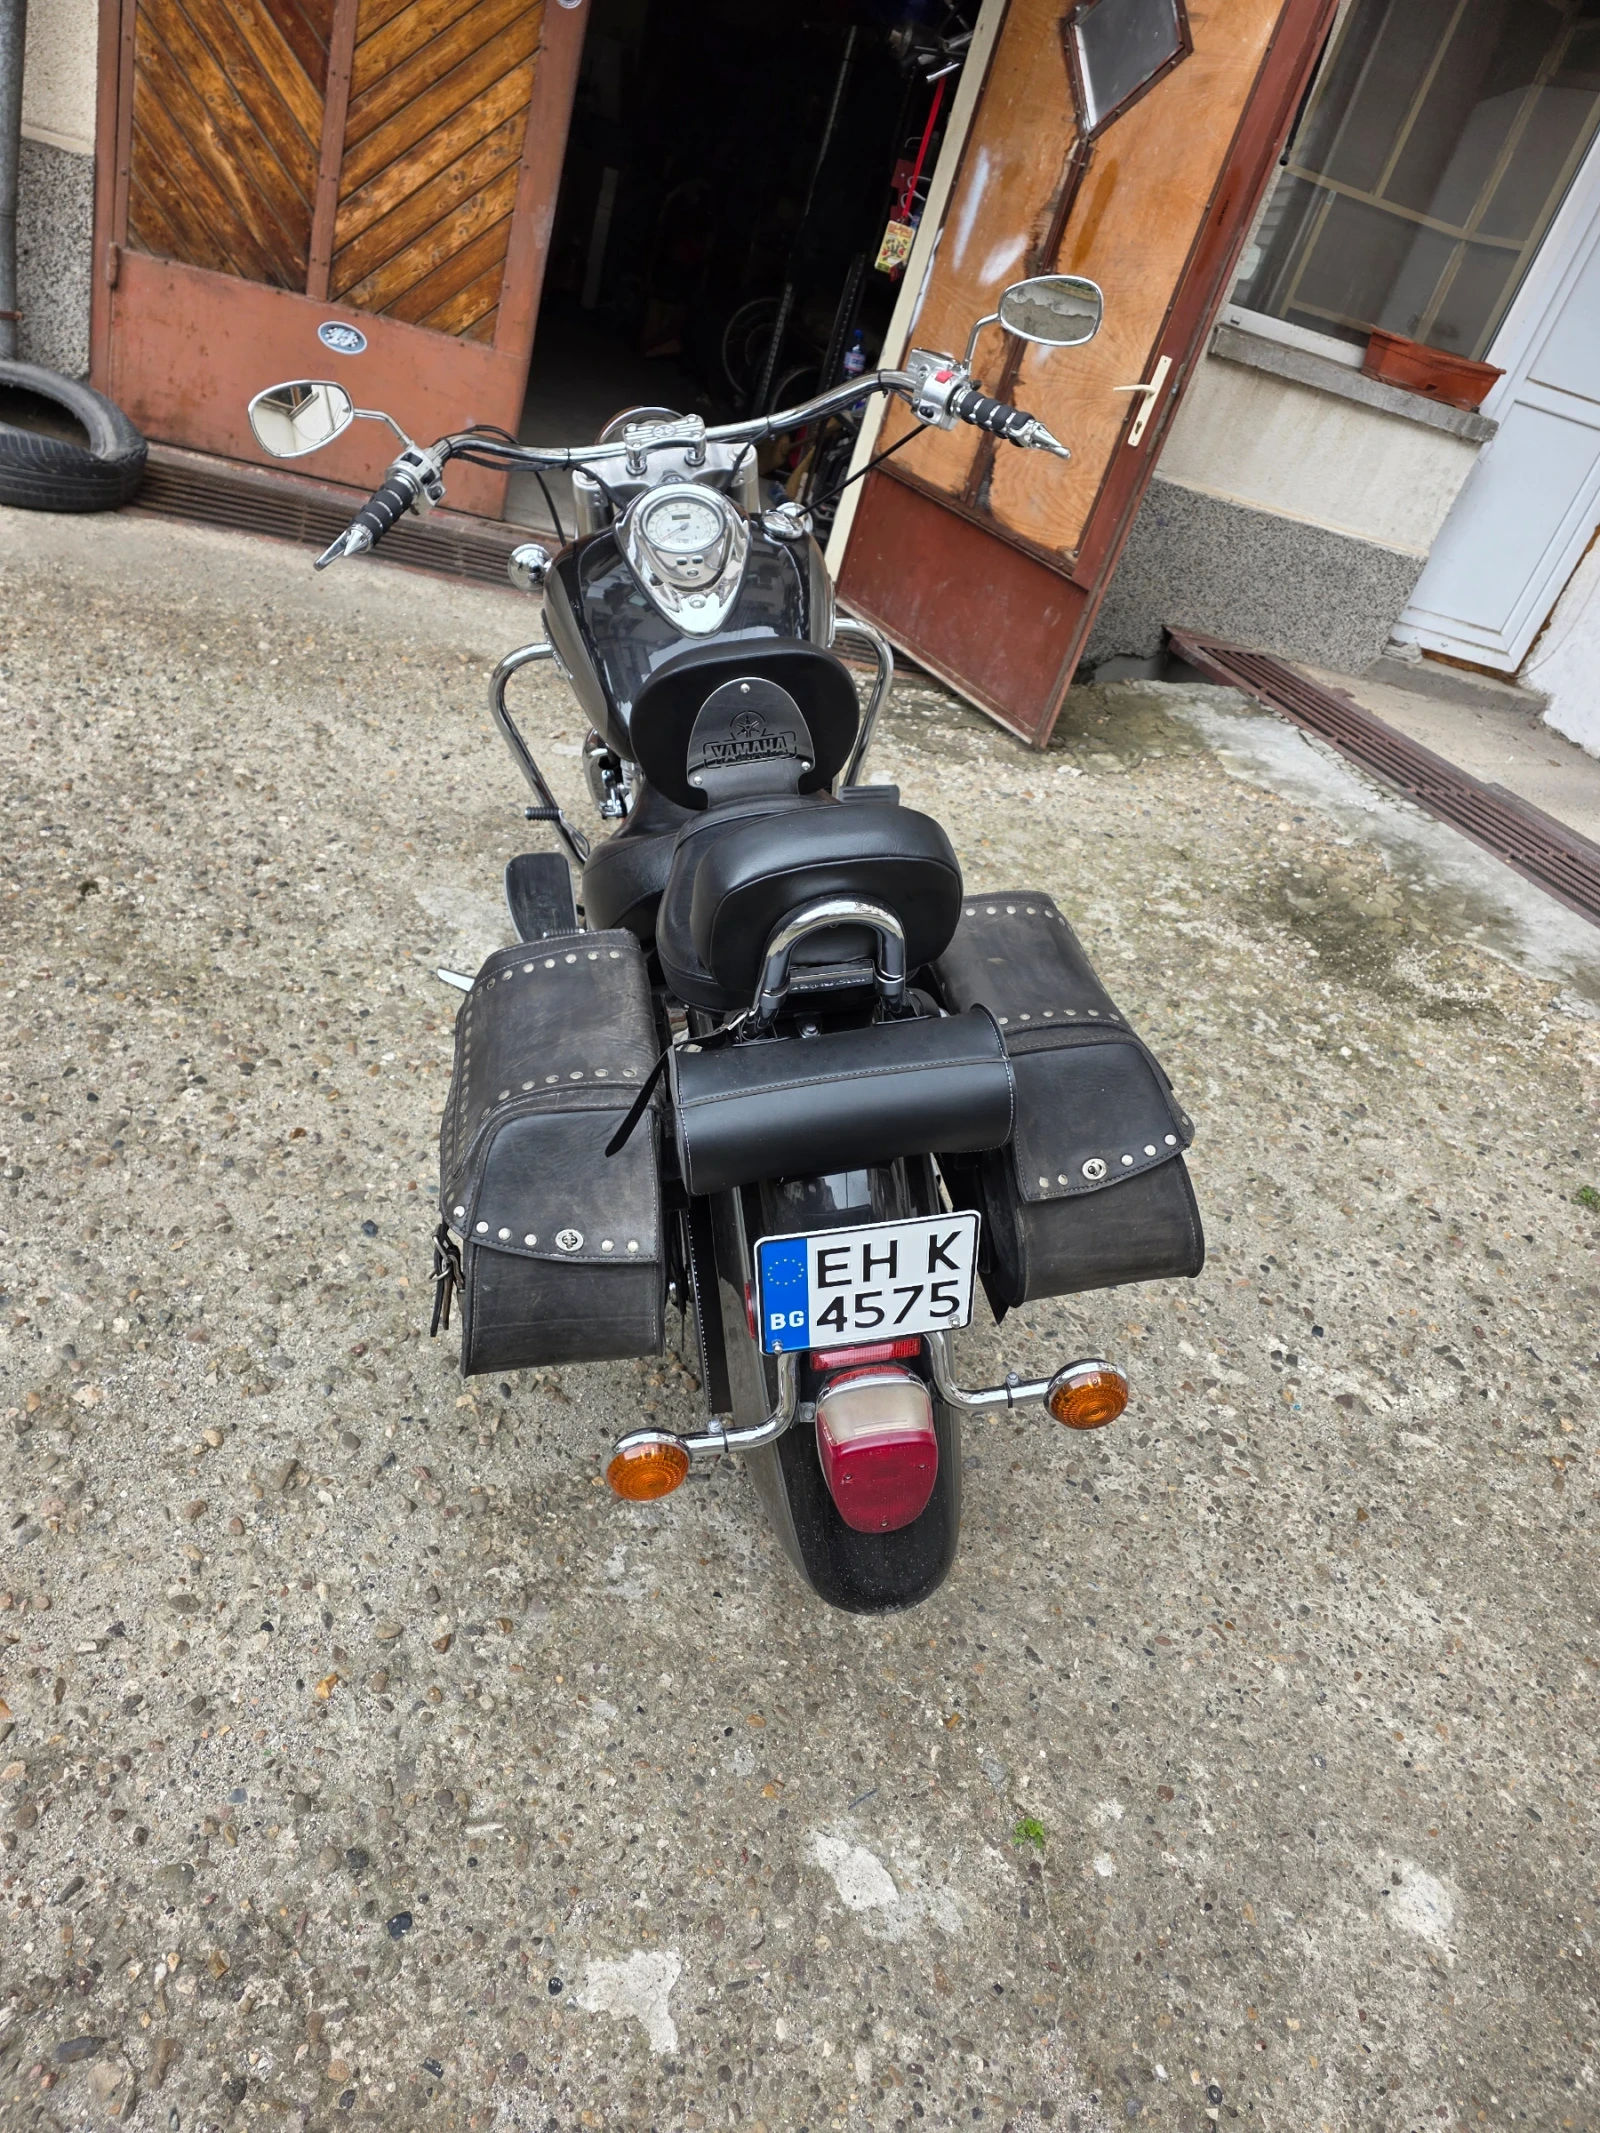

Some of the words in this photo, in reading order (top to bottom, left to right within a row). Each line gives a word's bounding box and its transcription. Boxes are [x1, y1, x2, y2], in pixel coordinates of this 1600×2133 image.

[711, 736, 790, 762] YAMAHA
[816, 1239, 898, 1289] EH
[927, 1230, 963, 1274] K
[770, 1310, 805, 1331] BG
[816, 1279, 961, 1333] 4575
